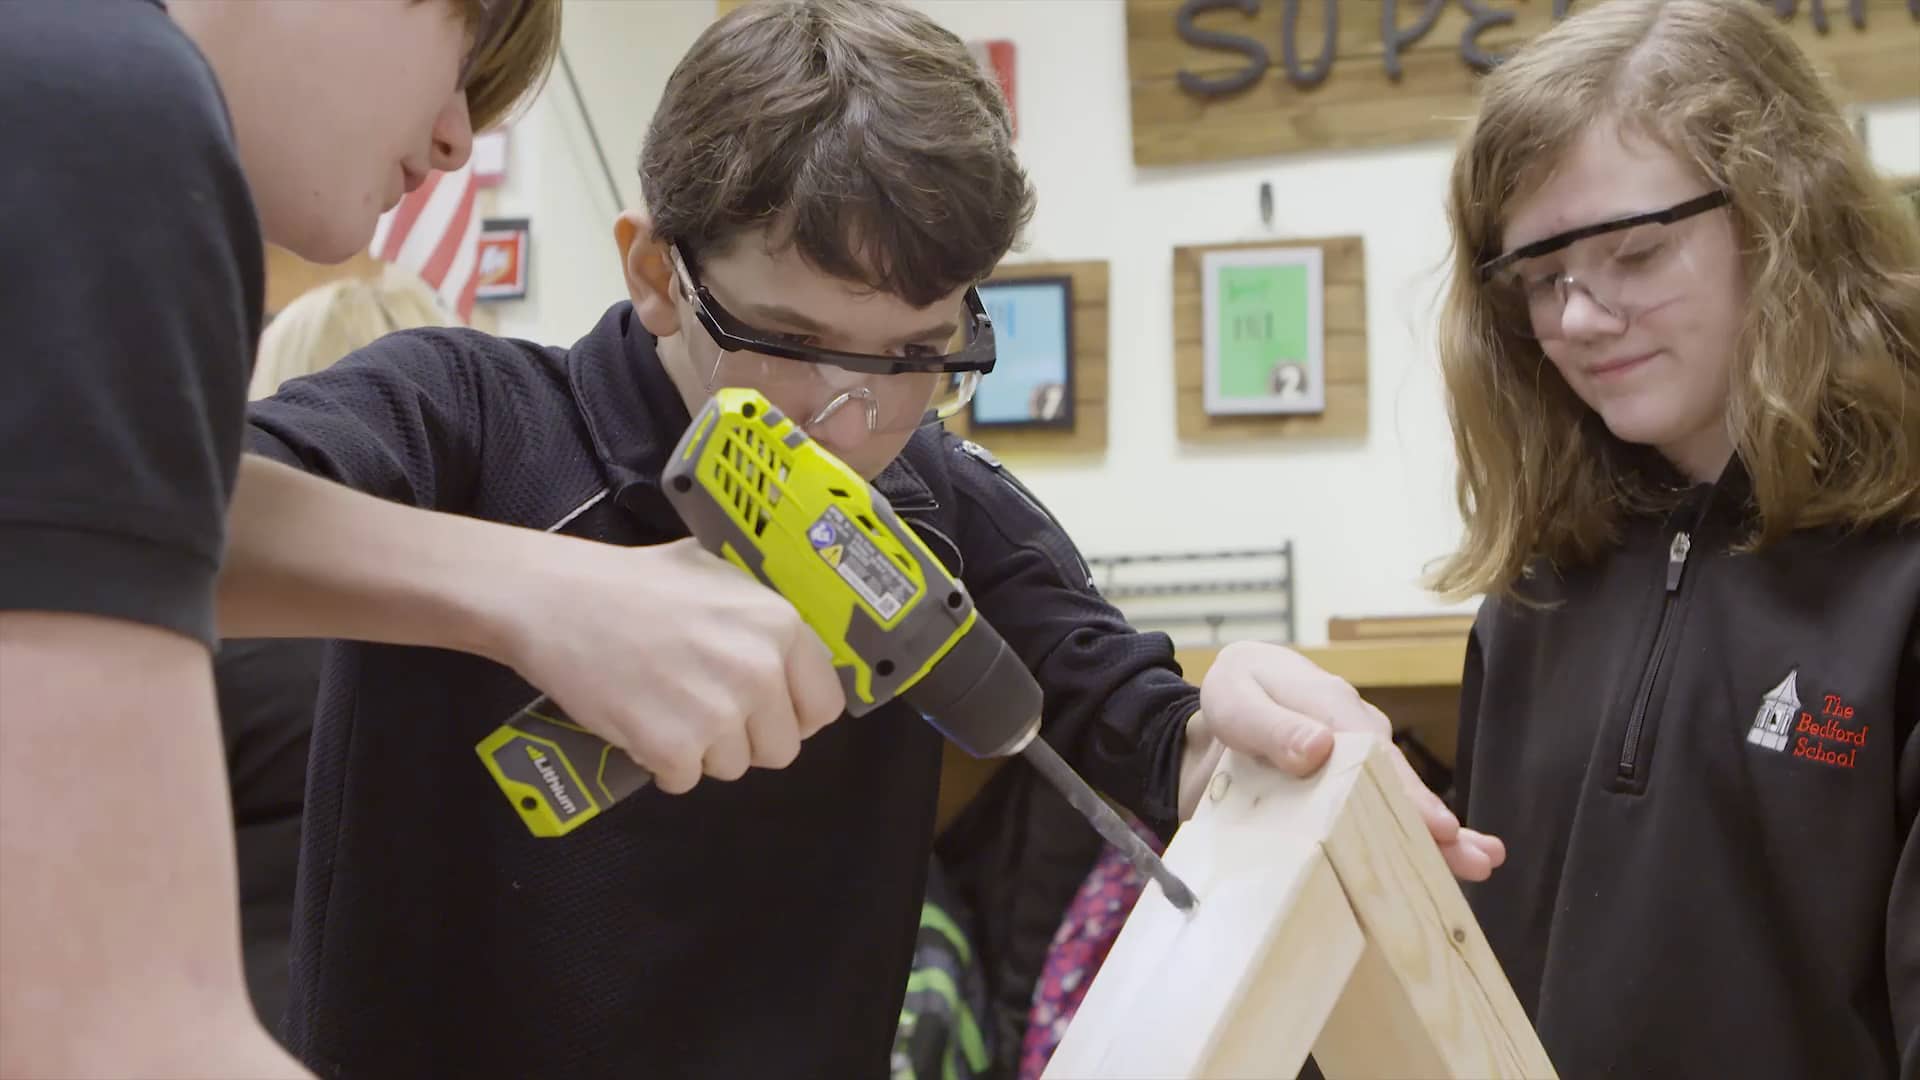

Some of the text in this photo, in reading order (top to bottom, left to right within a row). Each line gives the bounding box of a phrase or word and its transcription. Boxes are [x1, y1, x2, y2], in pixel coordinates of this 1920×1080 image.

[1176, 0, 1568, 96] SUPE
[1823, 695, 1855, 719] The
[1796, 712, 1869, 747] Bedford
[1793, 737, 1857, 768] School
[534, 757, 577, 814] Lithium
